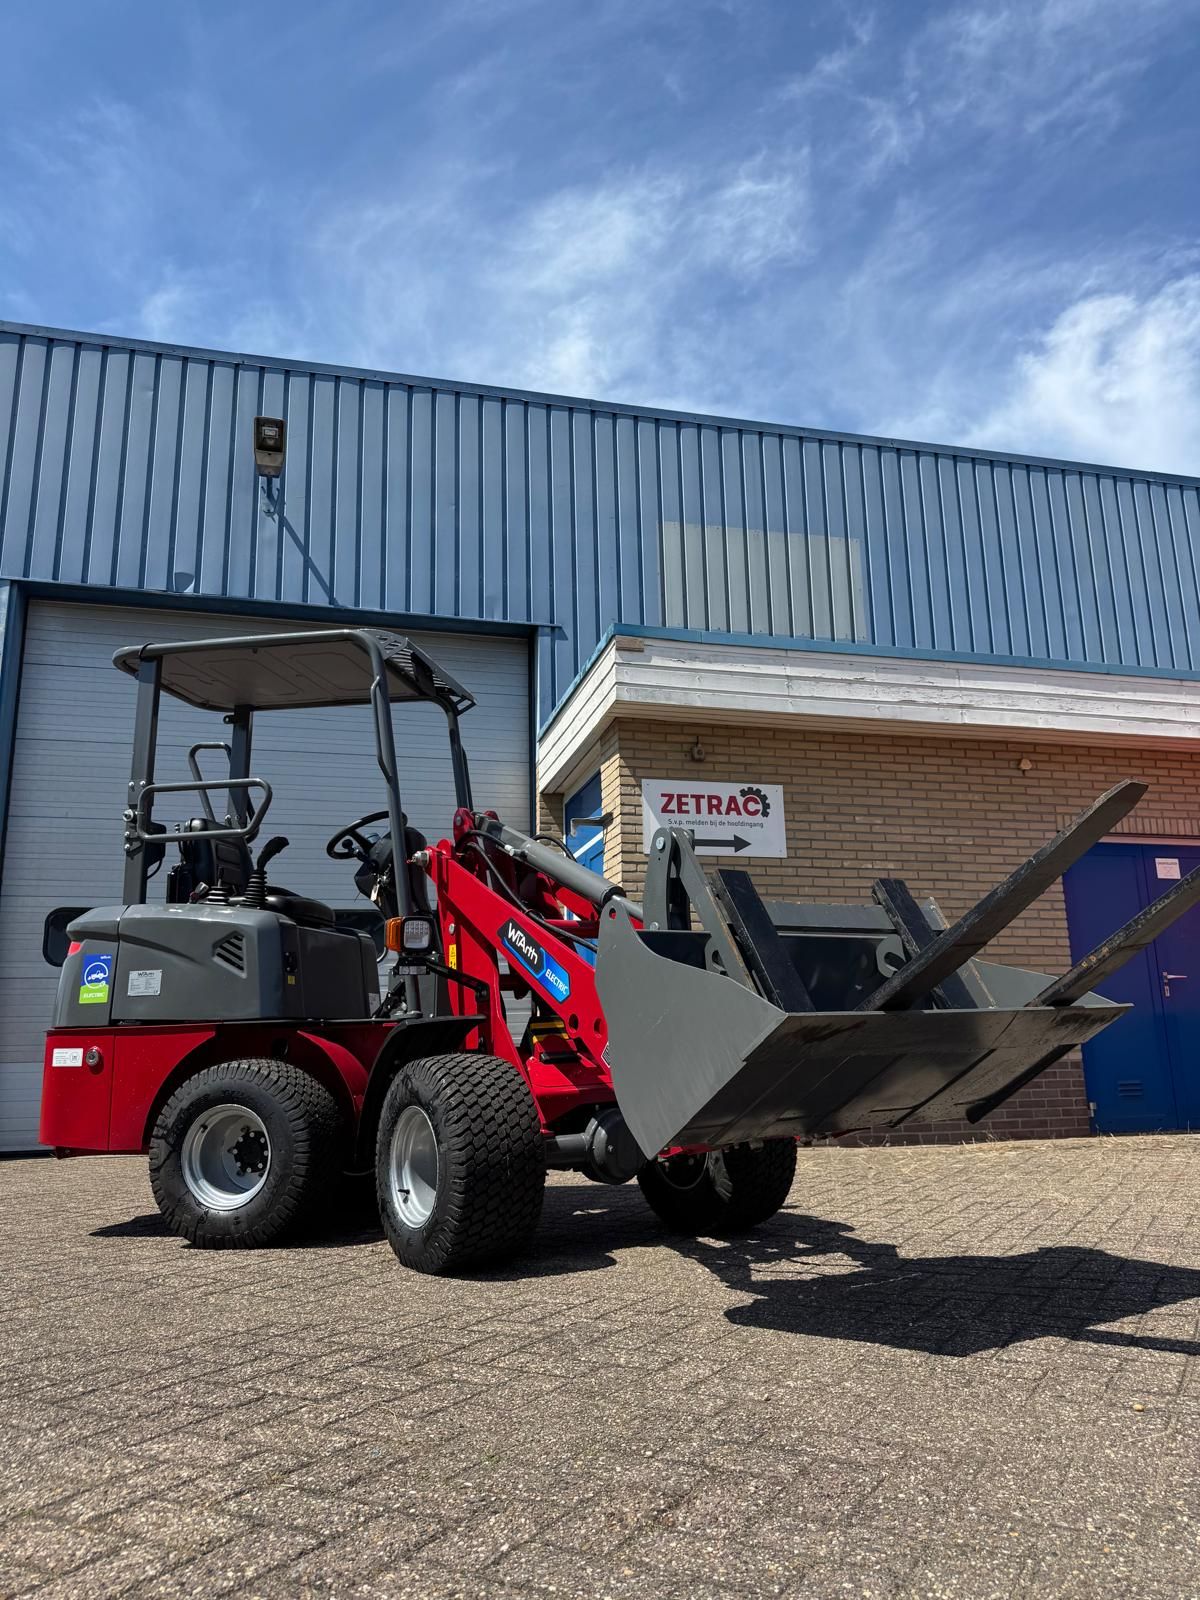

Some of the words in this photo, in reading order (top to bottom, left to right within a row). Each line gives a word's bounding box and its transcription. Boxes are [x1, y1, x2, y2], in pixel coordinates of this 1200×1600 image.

[660, 793, 761, 816] ZETRAC
[668, 818, 684, 826] S.v.p.
[709, 820, 718, 828] bij
[727, 821, 764, 829] hoofdingang
